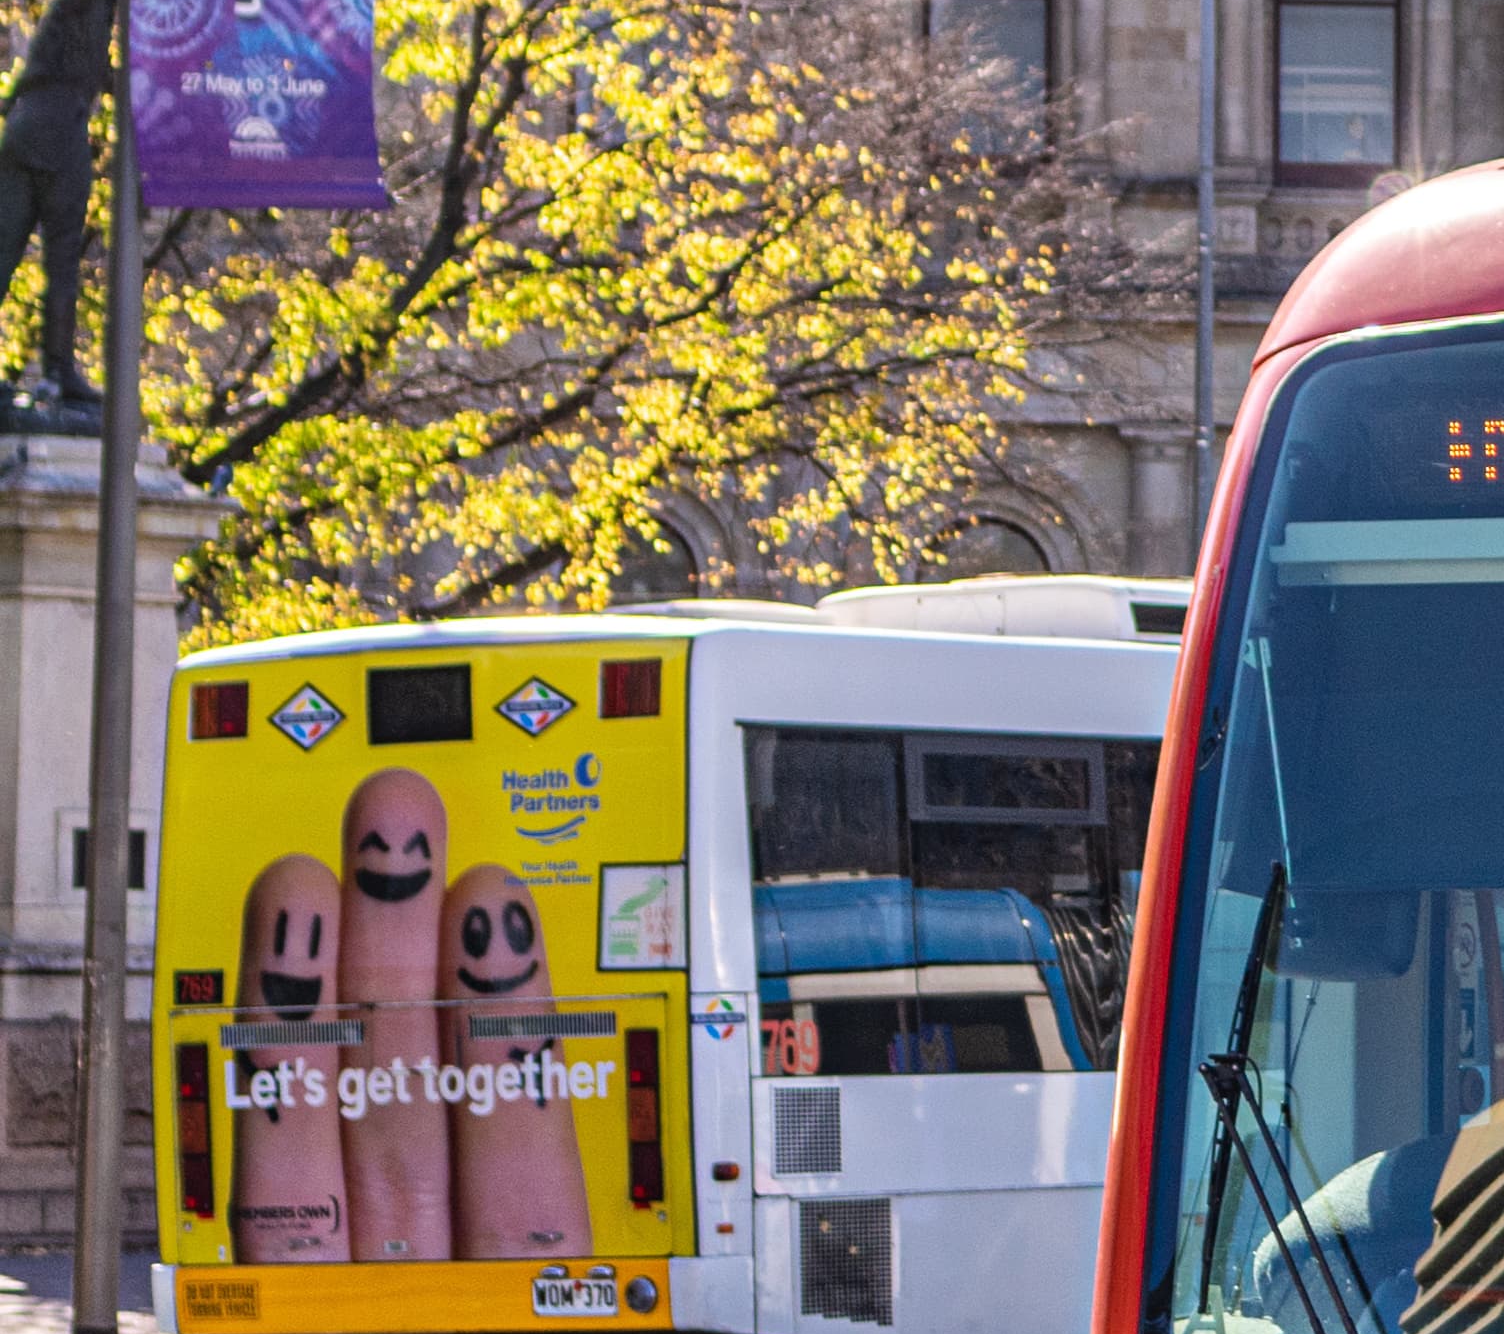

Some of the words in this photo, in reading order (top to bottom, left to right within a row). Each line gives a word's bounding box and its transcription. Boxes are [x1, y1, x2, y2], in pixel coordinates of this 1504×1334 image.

[181, 72, 202, 95] 27
[206, 74, 243, 98] May
[247, 76, 264, 94] to
[282, 77, 326, 98] June
[502, 769, 568, 791] Health
[510, 793, 600, 813] Partners
[179, 975, 214, 1000] 769
[761, 1019, 819, 1075] 769
[224, 1056, 326, 1109] Let's
[338, 1057, 411, 1120] get
[420, 1049, 616, 1116] together
[298, 1205, 331, 1219] OWN
[583, 1283, 614, 1307] 370
